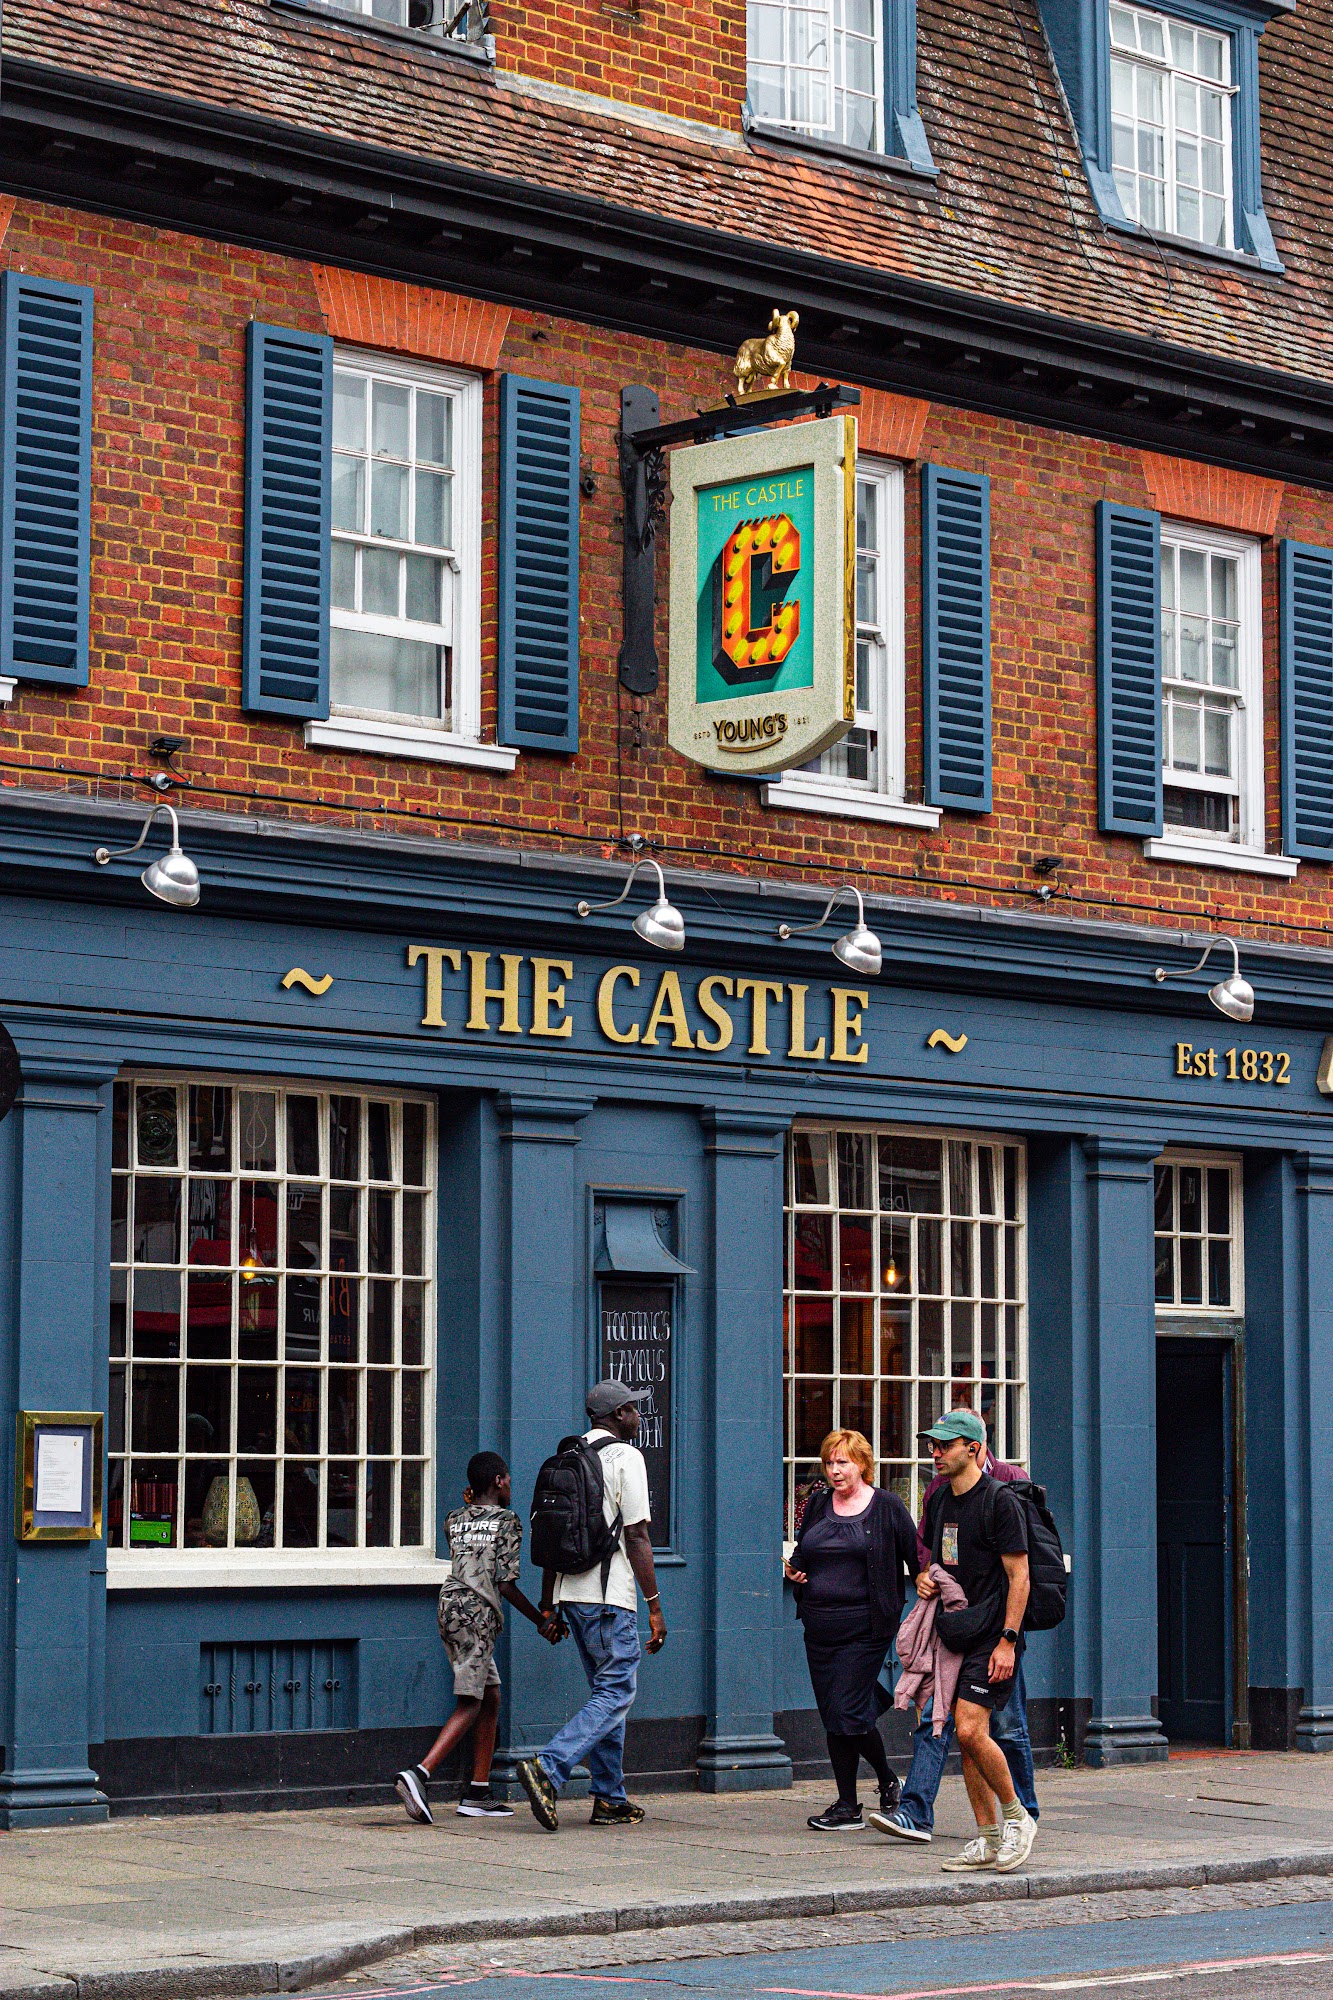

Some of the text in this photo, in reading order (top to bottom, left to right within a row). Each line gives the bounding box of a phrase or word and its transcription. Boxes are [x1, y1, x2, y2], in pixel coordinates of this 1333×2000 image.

[712, 479, 804, 511] THE CASTLE
[713, 713, 788, 742] YOUNG'S
[408, 945, 869, 1063] THE CASTLE
[1176, 1042, 1291, 1084] Est 1832
[608, 1349, 665, 1382] FAMOUS
[450, 1521, 499, 1535] FUTURE
